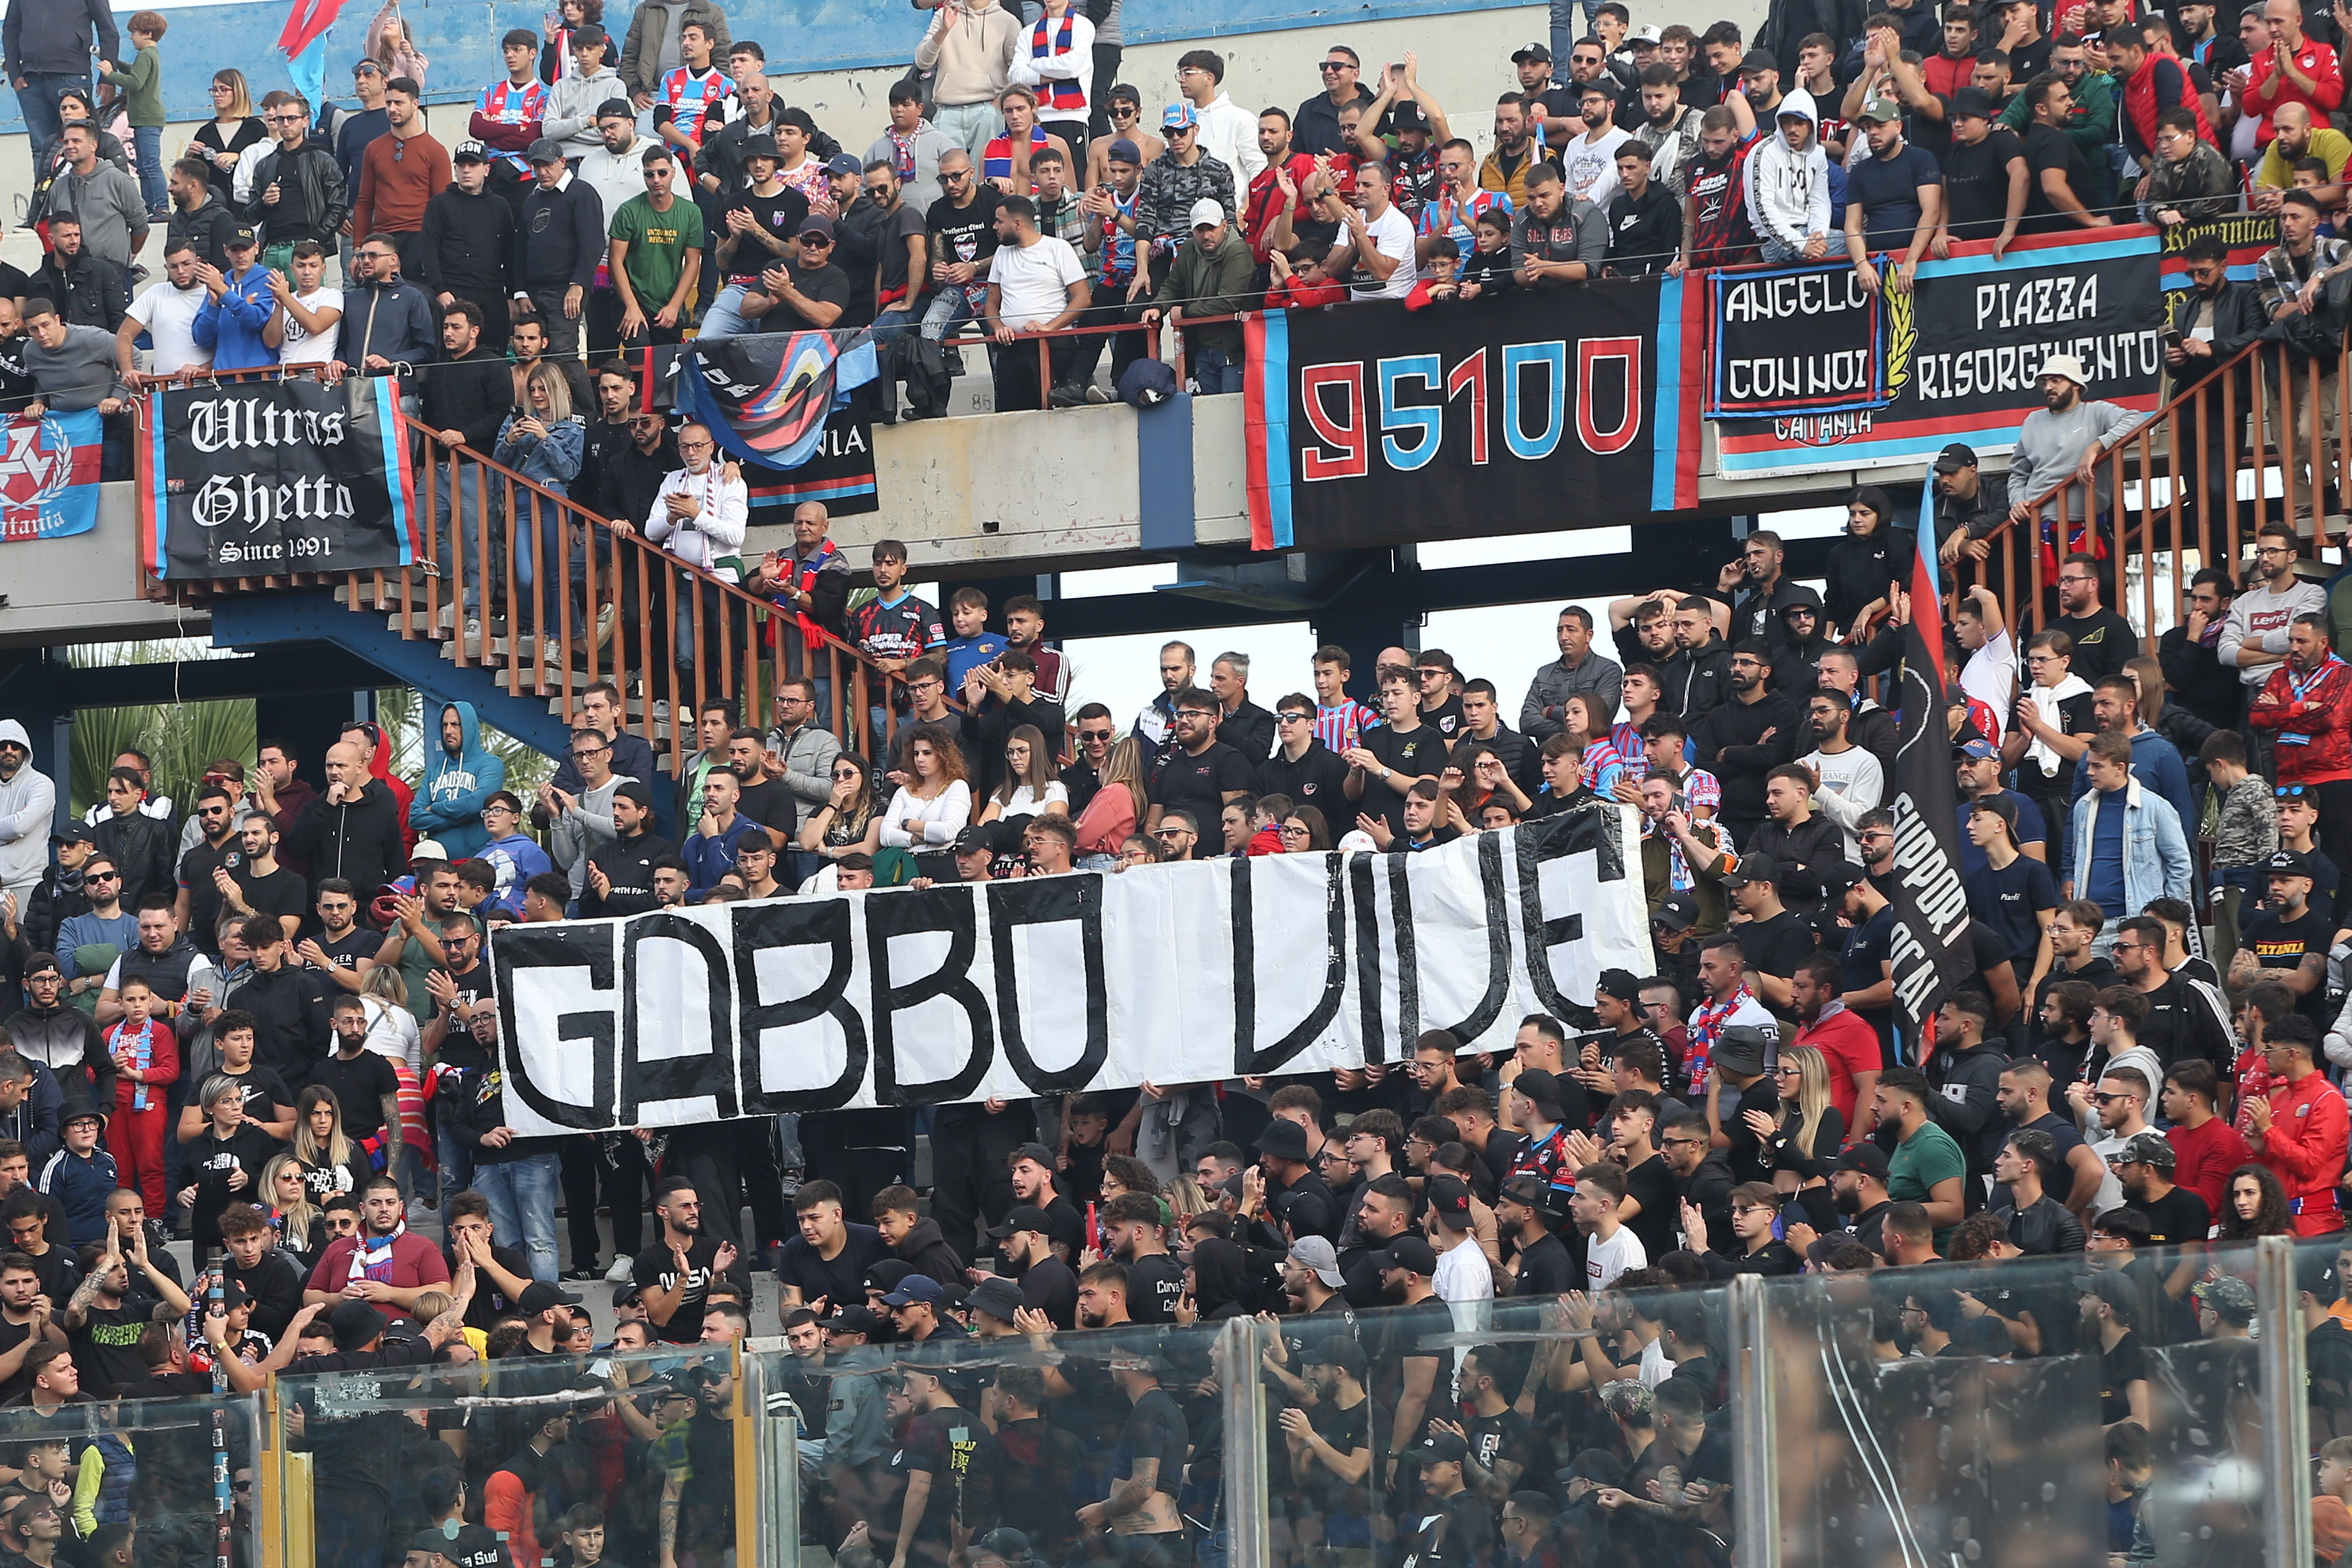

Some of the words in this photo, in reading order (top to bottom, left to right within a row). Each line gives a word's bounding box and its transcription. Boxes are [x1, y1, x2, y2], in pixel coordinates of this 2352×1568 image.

[457, 142, 481, 154] ICON
[2163, 217, 2276, 255] Romantica
[1726, 269, 1868, 323] ANGELO
[1976, 273, 2098, 331] PIAZZA
[1729, 356, 1800, 400] CON
[1807, 350, 1869, 397] NOI
[1917, 331, 2159, 401] RISORGIENTO
[188, 396, 346, 454] Ultras
[1301, 335, 1642, 482] 95100
[1774, 410, 1873, 441] CATANIA
[192, 471, 355, 533] Ghetto
[219, 540, 283, 564] Since
[288, 535, 333, 558] 1991
[868, 633, 903, 644] SUPER
[1822, 772, 1852, 781] RANGE
[492, 873, 1108, 1129] GABBO
[1231, 804, 1625, 1075] VIVE
[2256, 942, 2305, 956] CATANIA
[1890, 921, 1940, 1024] OCAL
[659, 1266, 710, 1291] NSA
[1157, 1280, 1180, 1295] Curva
[473, 1548, 498, 1566] Sud
